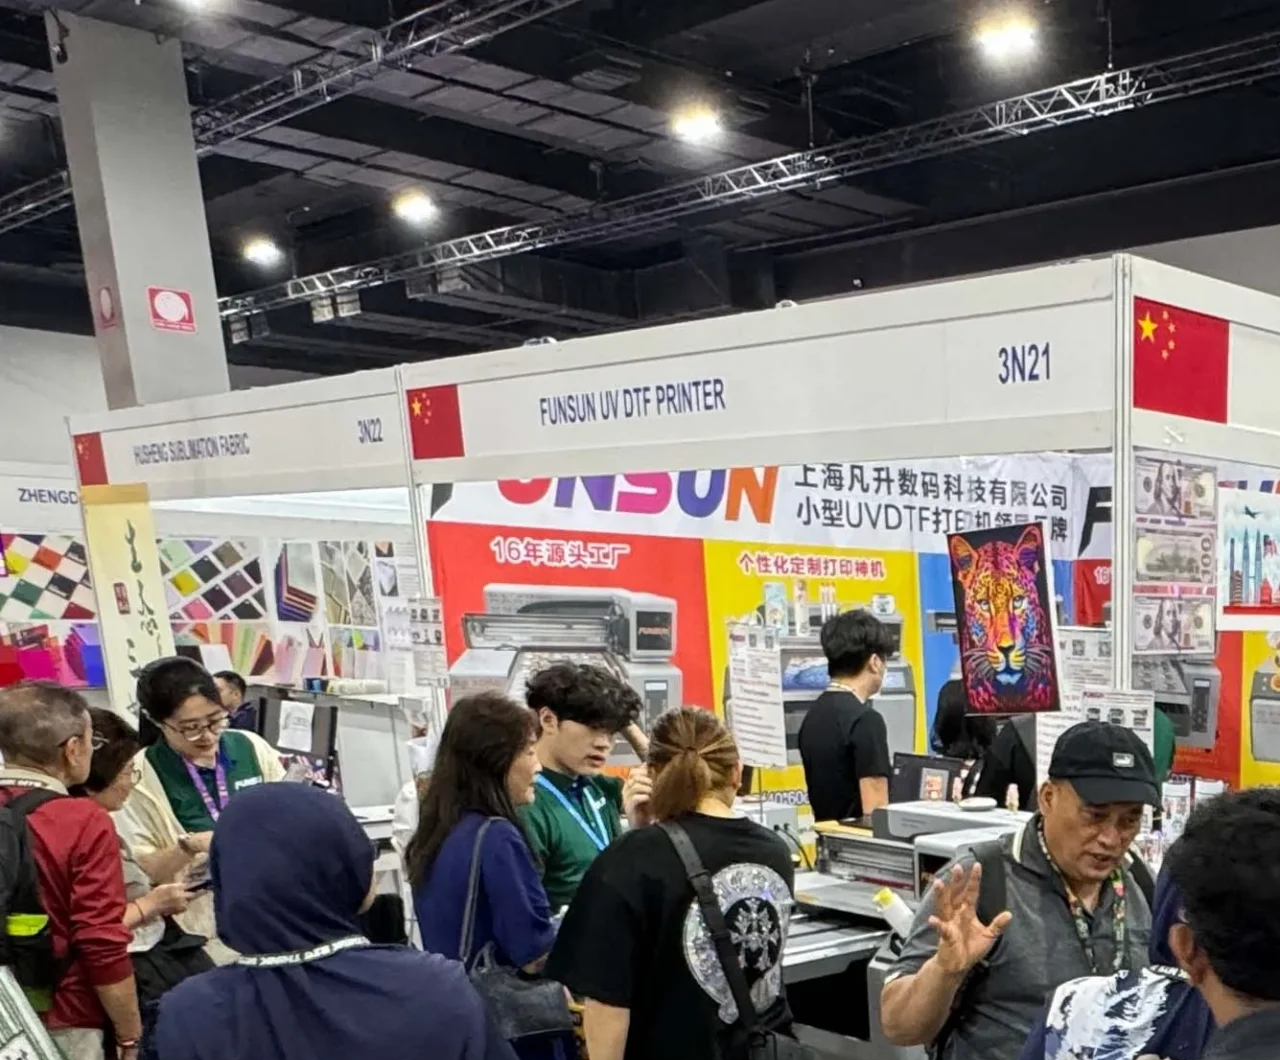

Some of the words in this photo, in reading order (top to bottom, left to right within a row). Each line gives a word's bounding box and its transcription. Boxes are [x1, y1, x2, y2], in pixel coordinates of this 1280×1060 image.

[998, 342, 1050, 385] 3N21
[540, 393, 596, 426] FUNSUN
[600, 389, 619, 420] UV
[623, 387, 650, 418] DTF
[656, 378, 726, 416] PRINTER
[220, 432, 251, 458] FABRIC
[357, 417, 384, 445] 3N22
[431, 466, 779, 524] NSUN
[491, 538, 629, 569] 16年源头工厂
[740, 552, 885, 578] 个性化定制打印神机
